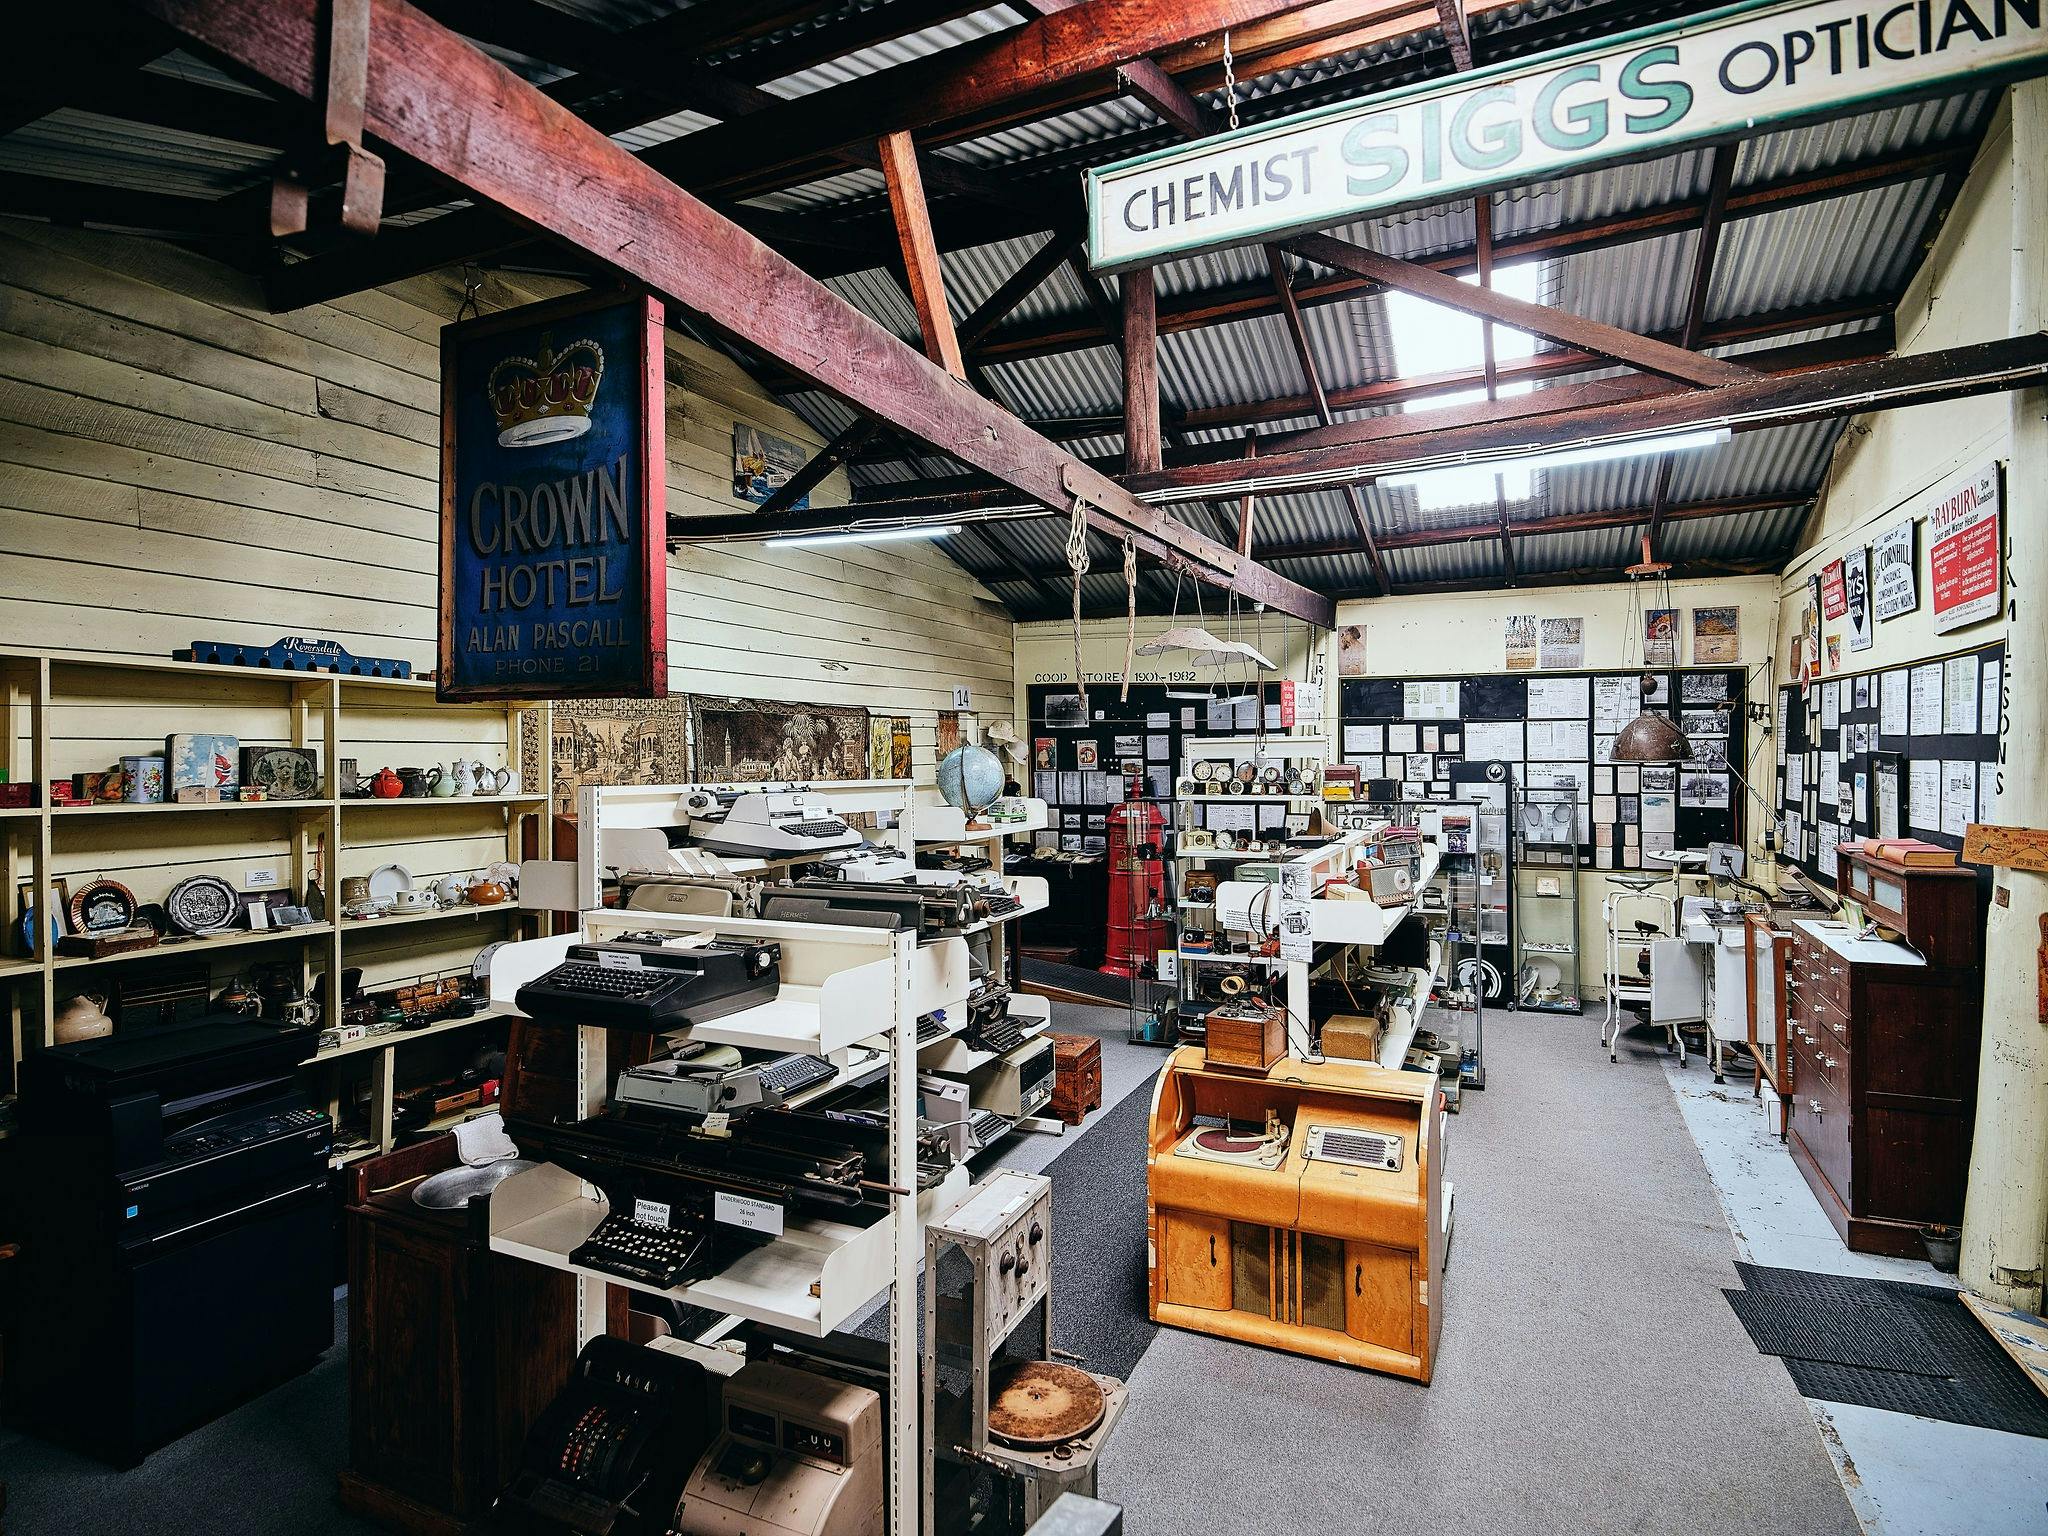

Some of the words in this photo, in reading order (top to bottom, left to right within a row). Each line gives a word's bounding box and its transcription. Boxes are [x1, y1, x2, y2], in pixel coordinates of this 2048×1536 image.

[1122, 146, 1318, 233] CHEMIST
[1340, 44, 1695, 198] SIGGS
[470, 453, 630, 556] CROWN
[1935, 484, 1977, 530] RAYBURN
[1880, 543, 1911, 571] CORNHILL
[481, 555, 624, 612] HOTEL
[468, 624, 519, 653] ALAN
[533, 618, 630, 651] PASCALL
[495, 657, 565, 675] PHONE
[578, 654, 600, 673] 21
[1034, 673, 1068, 683] COOP
[956, 689, 969, 707] 14
[636, 1200, 658, 1214] Please
[658, 1206, 668, 1214] do
[720, 1195, 750, 1206] UNDERWOOD
[750, 1200, 775, 1212] STANDARD
[635, 1212, 647, 1222] not
[647, 1212, 665, 1224] touch
[741, 1219, 753, 1227] 1917
